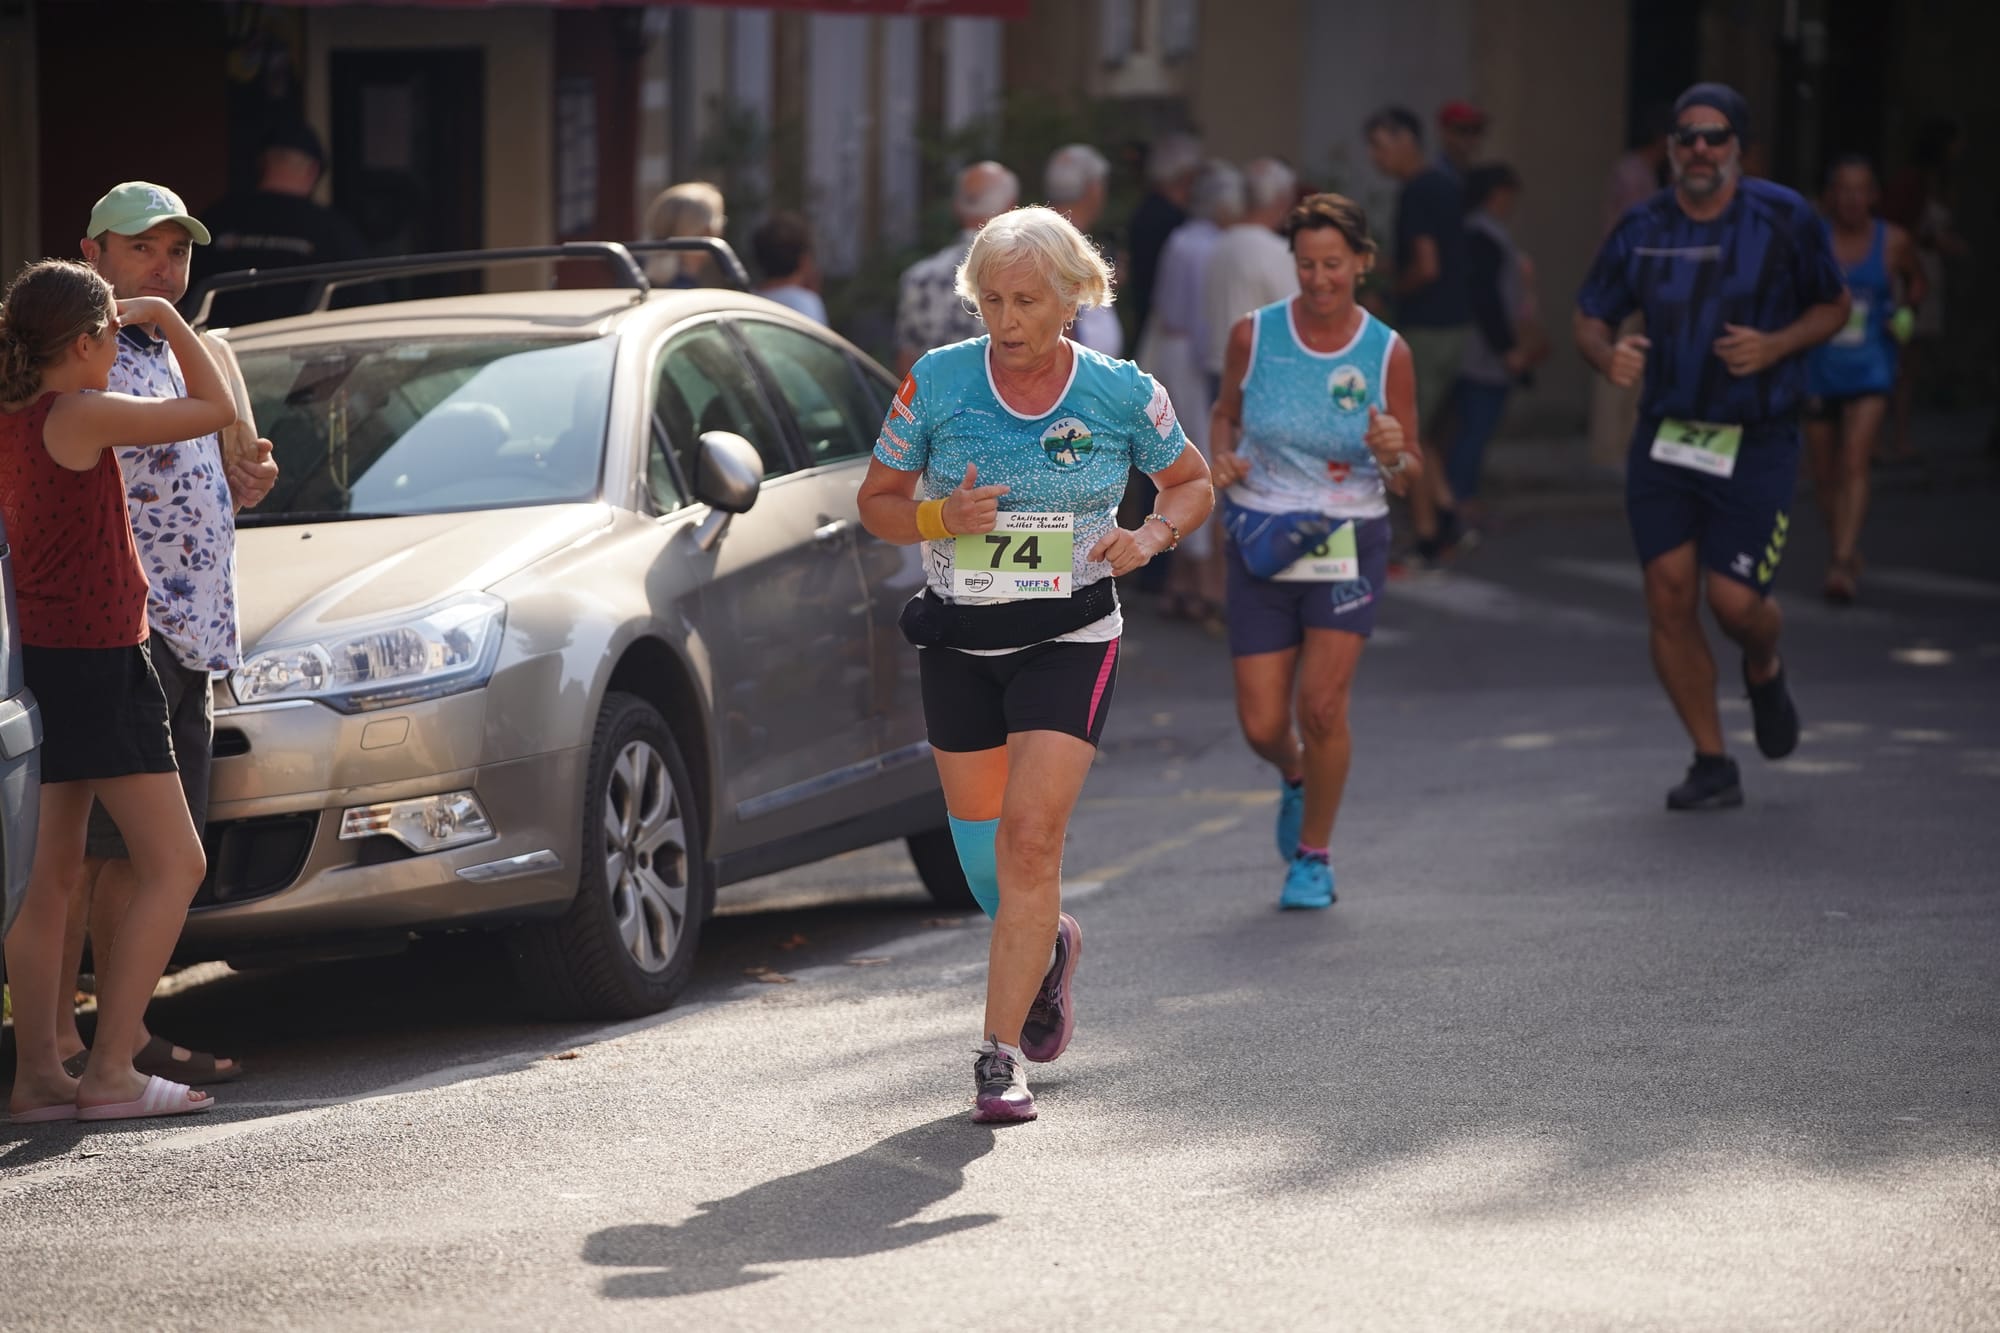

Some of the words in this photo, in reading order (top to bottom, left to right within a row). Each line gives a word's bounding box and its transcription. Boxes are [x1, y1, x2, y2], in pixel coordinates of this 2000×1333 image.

[1010, 514, 1048, 524] Challenge
[985, 535, 1042, 569] 74
[965, 578, 989, 587] BFP
